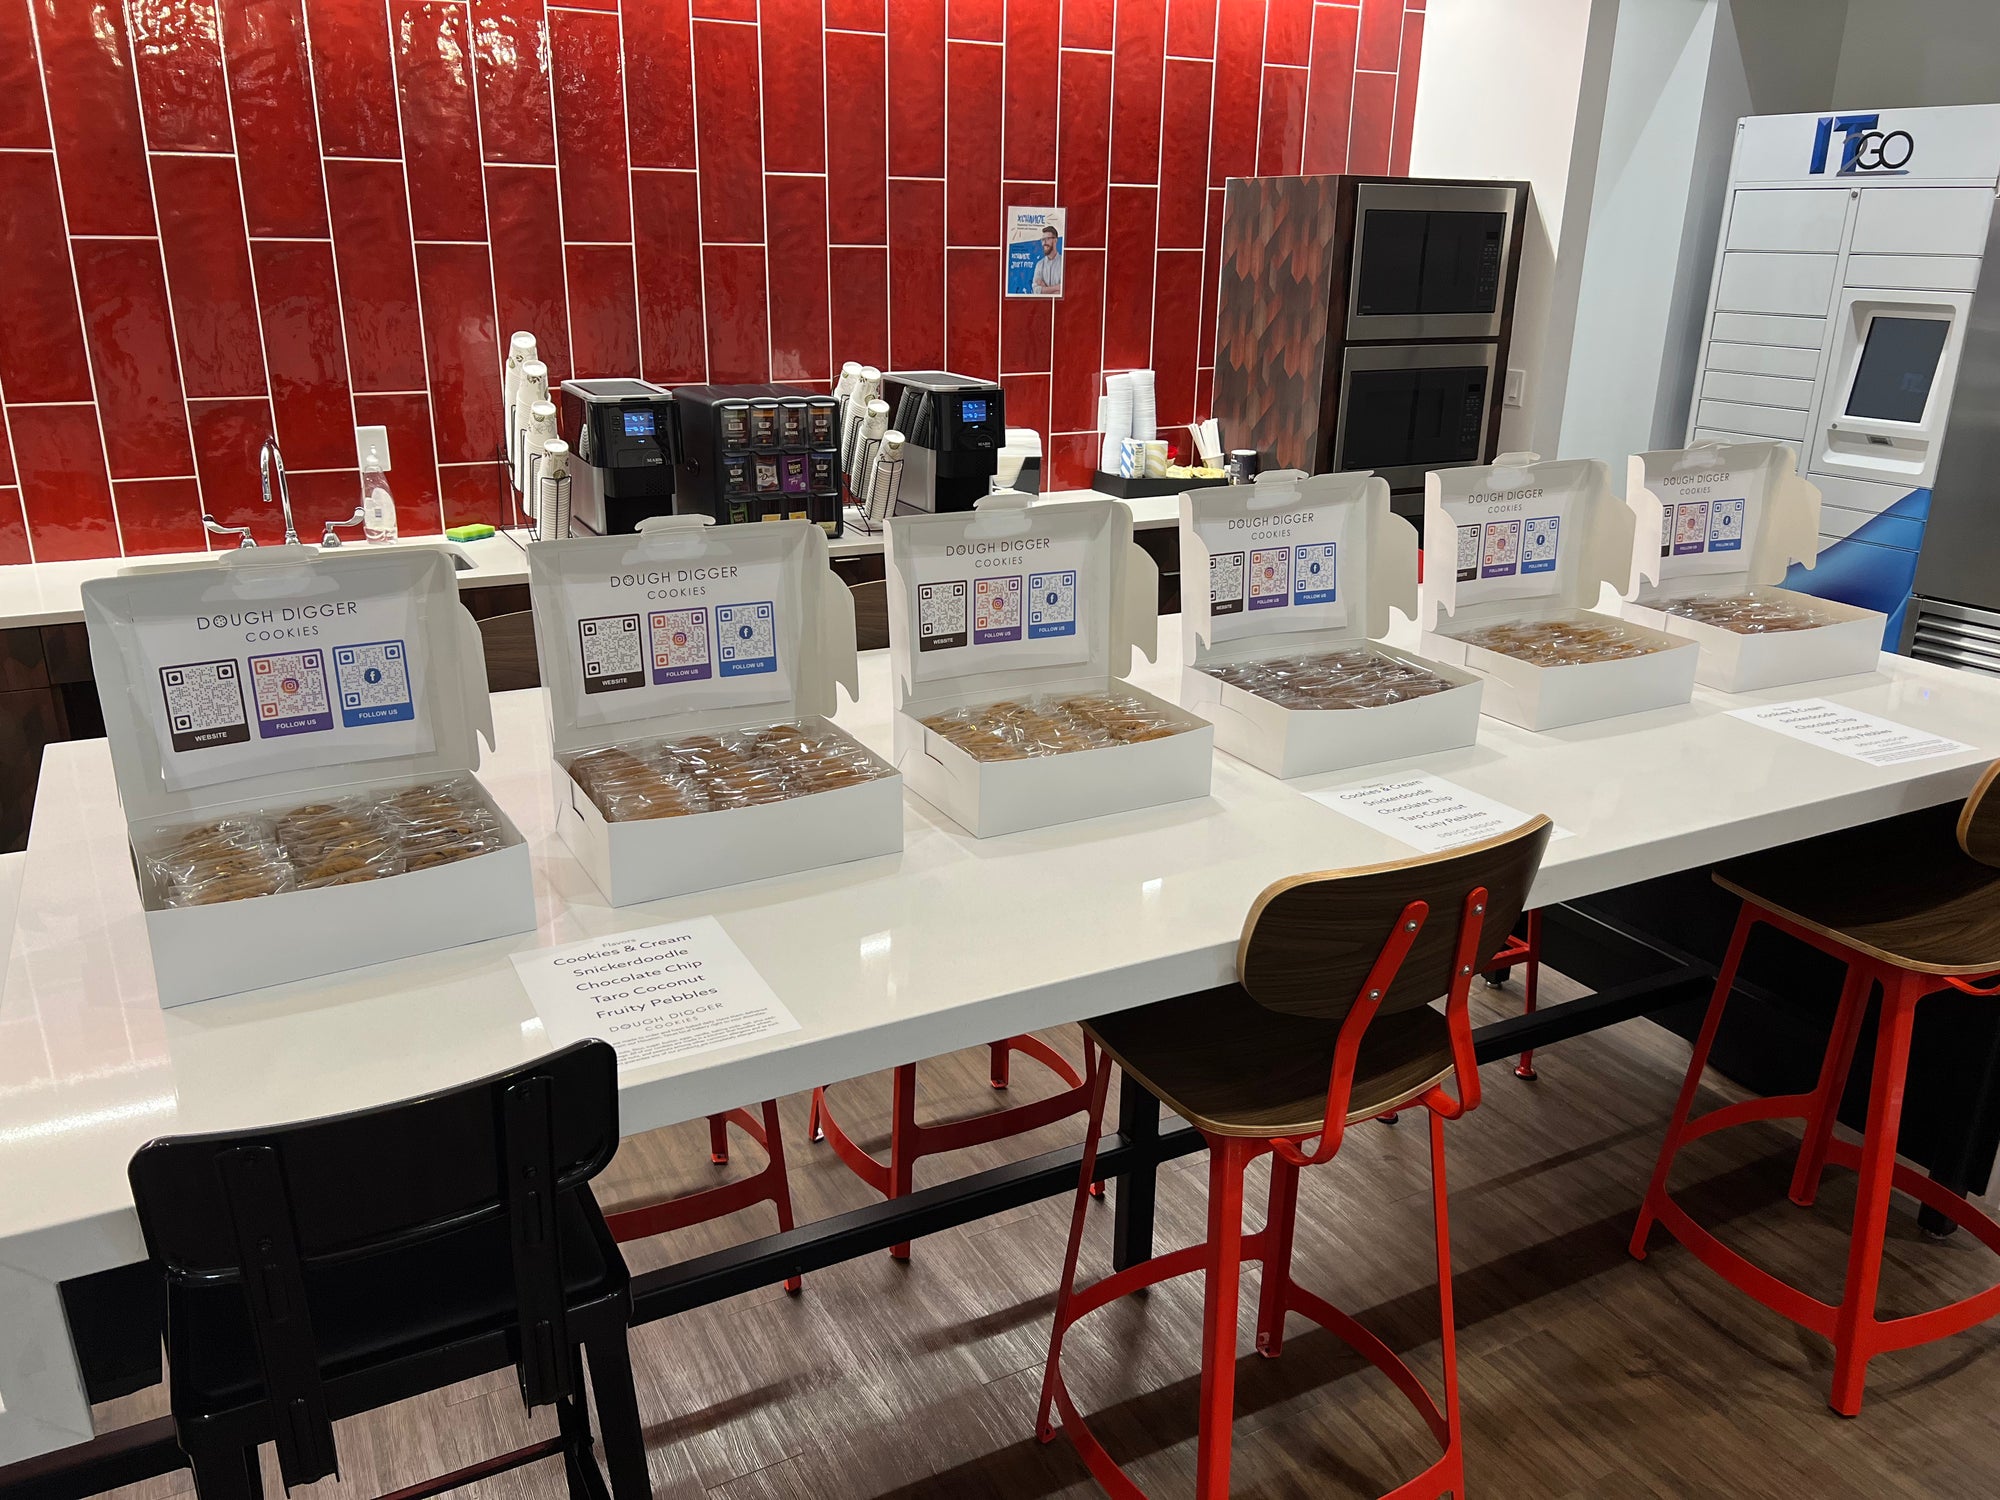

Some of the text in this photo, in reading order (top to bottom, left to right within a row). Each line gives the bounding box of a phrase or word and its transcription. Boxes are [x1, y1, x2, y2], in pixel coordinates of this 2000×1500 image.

[1663, 473, 1730, 486] DOUGH DIGGER
[1468, 489, 1544, 504] DOUGH DIGGER
[1488, 504, 1522, 514] COOKIES
[1228, 512, 1314, 530] DOUGH DIGGER
[1251, 530, 1292, 540] COOKIES
[946, 538, 1050, 556] DOUGH DIGGER
[975, 556, 1024, 568] COOKIES
[610, 566, 738, 588] DOUGH DIGGER
[647, 586, 706, 600] COOKIES
[197, 600, 358, 631] DOUGH DIGGER
[245, 624, 320, 643] COOKIES
[666, 670, 690, 678] FOLLOW
[732, 662, 756, 670] FOLLOW
[602, 677, 628, 686] WEBSITE
[358, 708, 398, 719] FOLLOW US
[276, 718, 317, 730] FOLLOW US
[194, 731, 228, 742] WEBSITE
[1340, 788, 1382, 800] Cookies
[1389, 780, 1423, 790] Cream
[1363, 788, 1433, 806] Snickerdoodle
[1378, 795, 1453, 815] Chocolate Chip
[1399, 804, 1467, 822] Taro Coconut
[1414, 812, 1487, 831] Fruity Pebbles
[553, 932, 692, 966] Cookies & Cream
[602, 937, 637, 948] Flavors
[573, 949, 689, 977] Snickerdoodle
[576, 960, 703, 992] Chocolate Chip
[590, 974, 706, 1004] Taro Coconut
[596, 986, 718, 1019] Fruity Pebbles
[609, 1002, 724, 1032] DOUGH DIGGER
[645, 1016, 698, 1031] COOKIES
